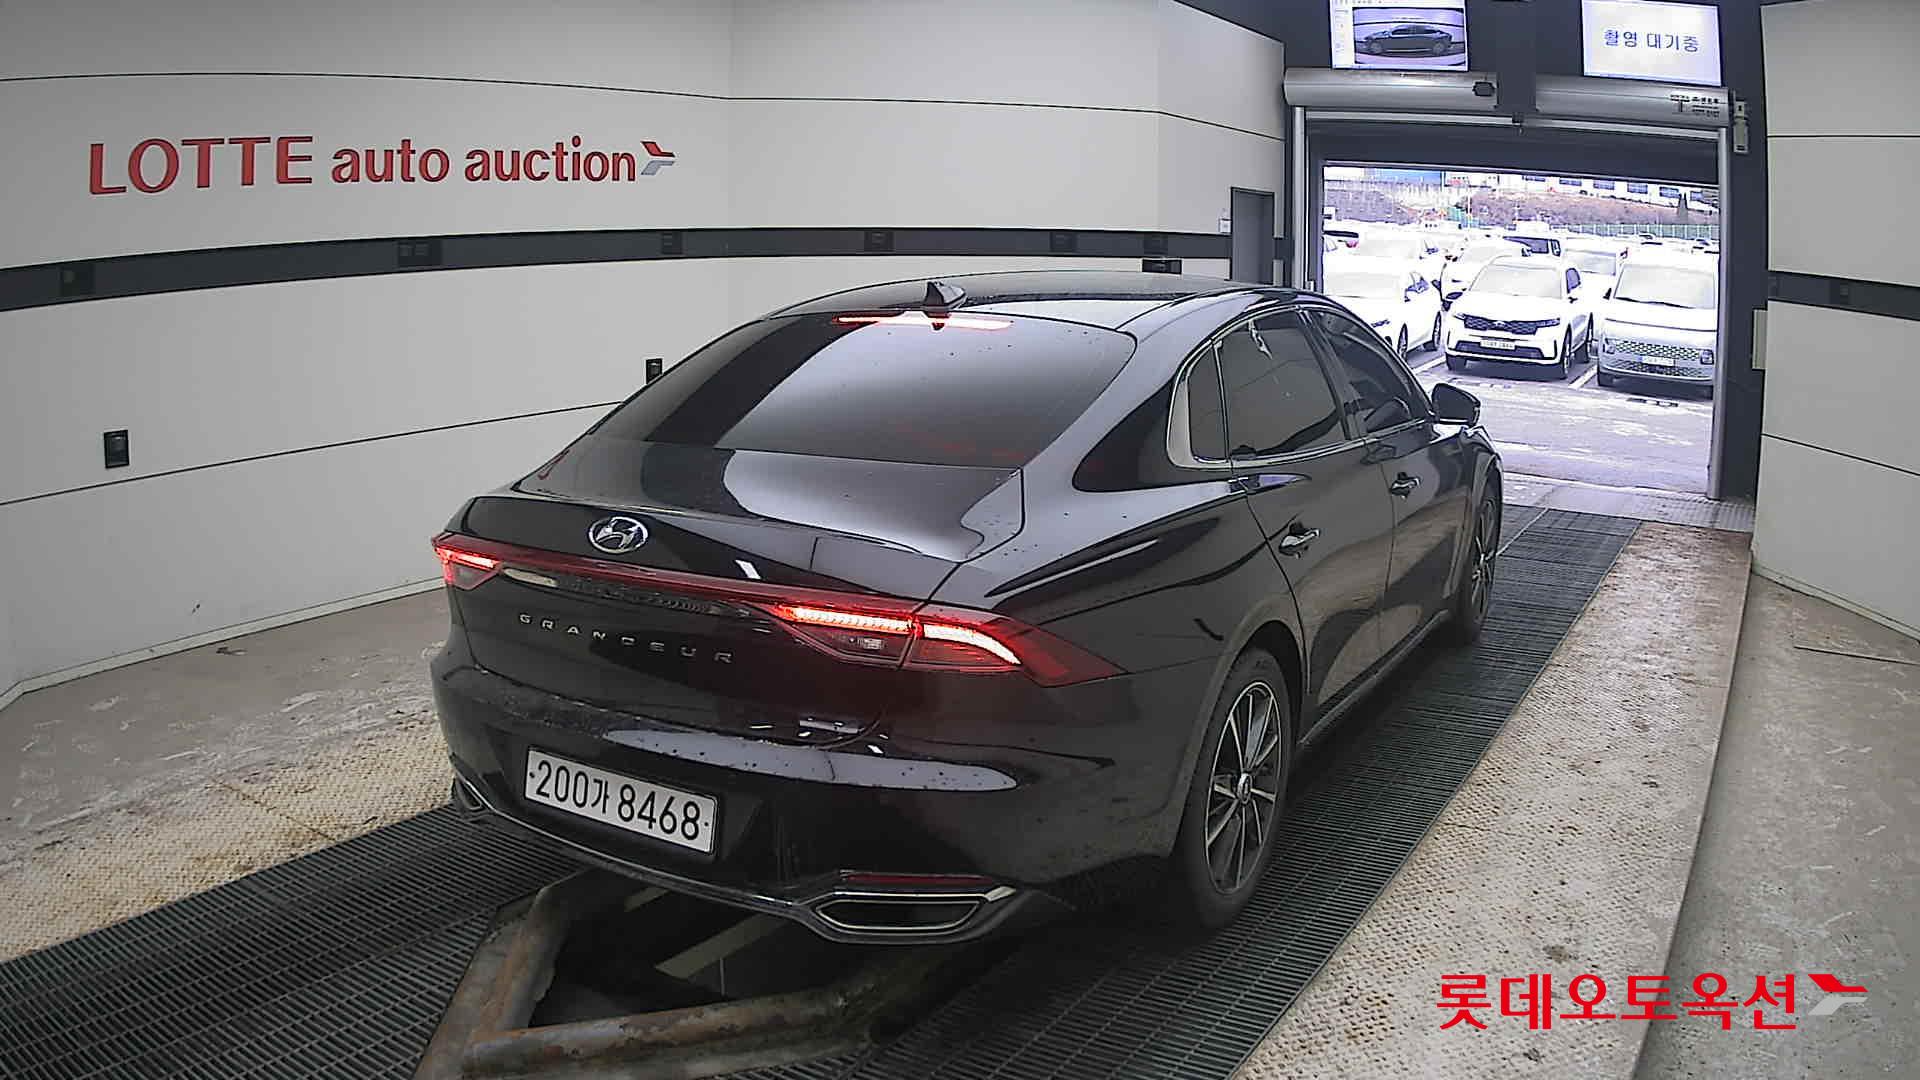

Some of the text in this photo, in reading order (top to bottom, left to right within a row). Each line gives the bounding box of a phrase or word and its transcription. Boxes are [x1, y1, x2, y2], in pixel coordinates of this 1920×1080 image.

[1603, 29, 1700, 53] 촬영 대기중
[89, 135, 637, 195] LOTTE auto auction
[519, 614, 734, 664] GRANDEUR
[617, 783, 701, 841] 8468
